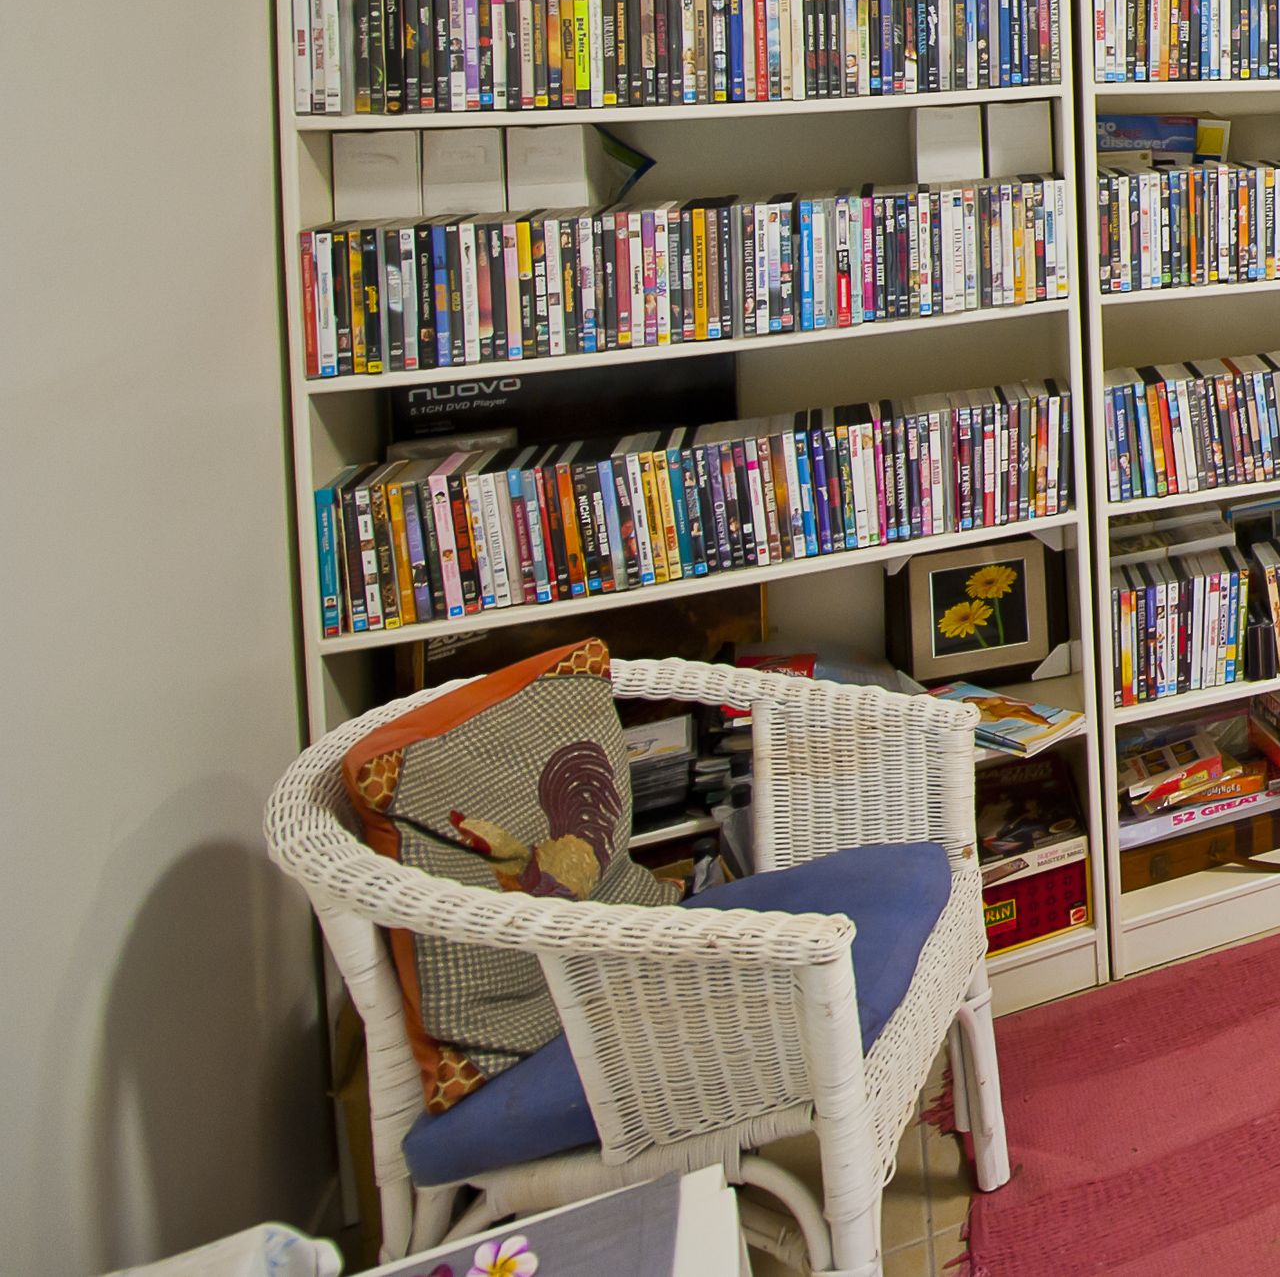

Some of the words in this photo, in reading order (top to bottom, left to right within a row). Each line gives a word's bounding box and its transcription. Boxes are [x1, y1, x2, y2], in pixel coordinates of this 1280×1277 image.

[1050, 24, 1059, 60] MORANT
[1201, 36, 1209, 52] Wild
[1265, 188, 1274, 228] KINGPIN
[744, 240, 753, 263] HIGH
[864, 228, 872, 250] HOTEL
[876, 236, 884, 256] HOUSE
[953, 228, 962, 275] IDENTITY
[670, 233, 679, 289] HALLOWEEN
[864, 252, 872, 262] de
[745, 266, 754, 298] CRIMES
[864, 263, 872, 283] LOVE
[408, 378, 521, 402] nuovo
[446, 401, 469, 411] DVD
[473, 398, 508, 409] Player
[895, 452, 909, 509] PROPOSITION
[484, 490, 496, 521] HOUSE
[578, 495, 591, 524] NIGHT
[489, 531, 503, 567] UMBRIA
[583, 526, 595, 552] TRAIN
[1172, 811, 1196, 826] 52
[1201, 794, 1260, 817] GREAT
[1037, 853, 1065, 867] MASTER
